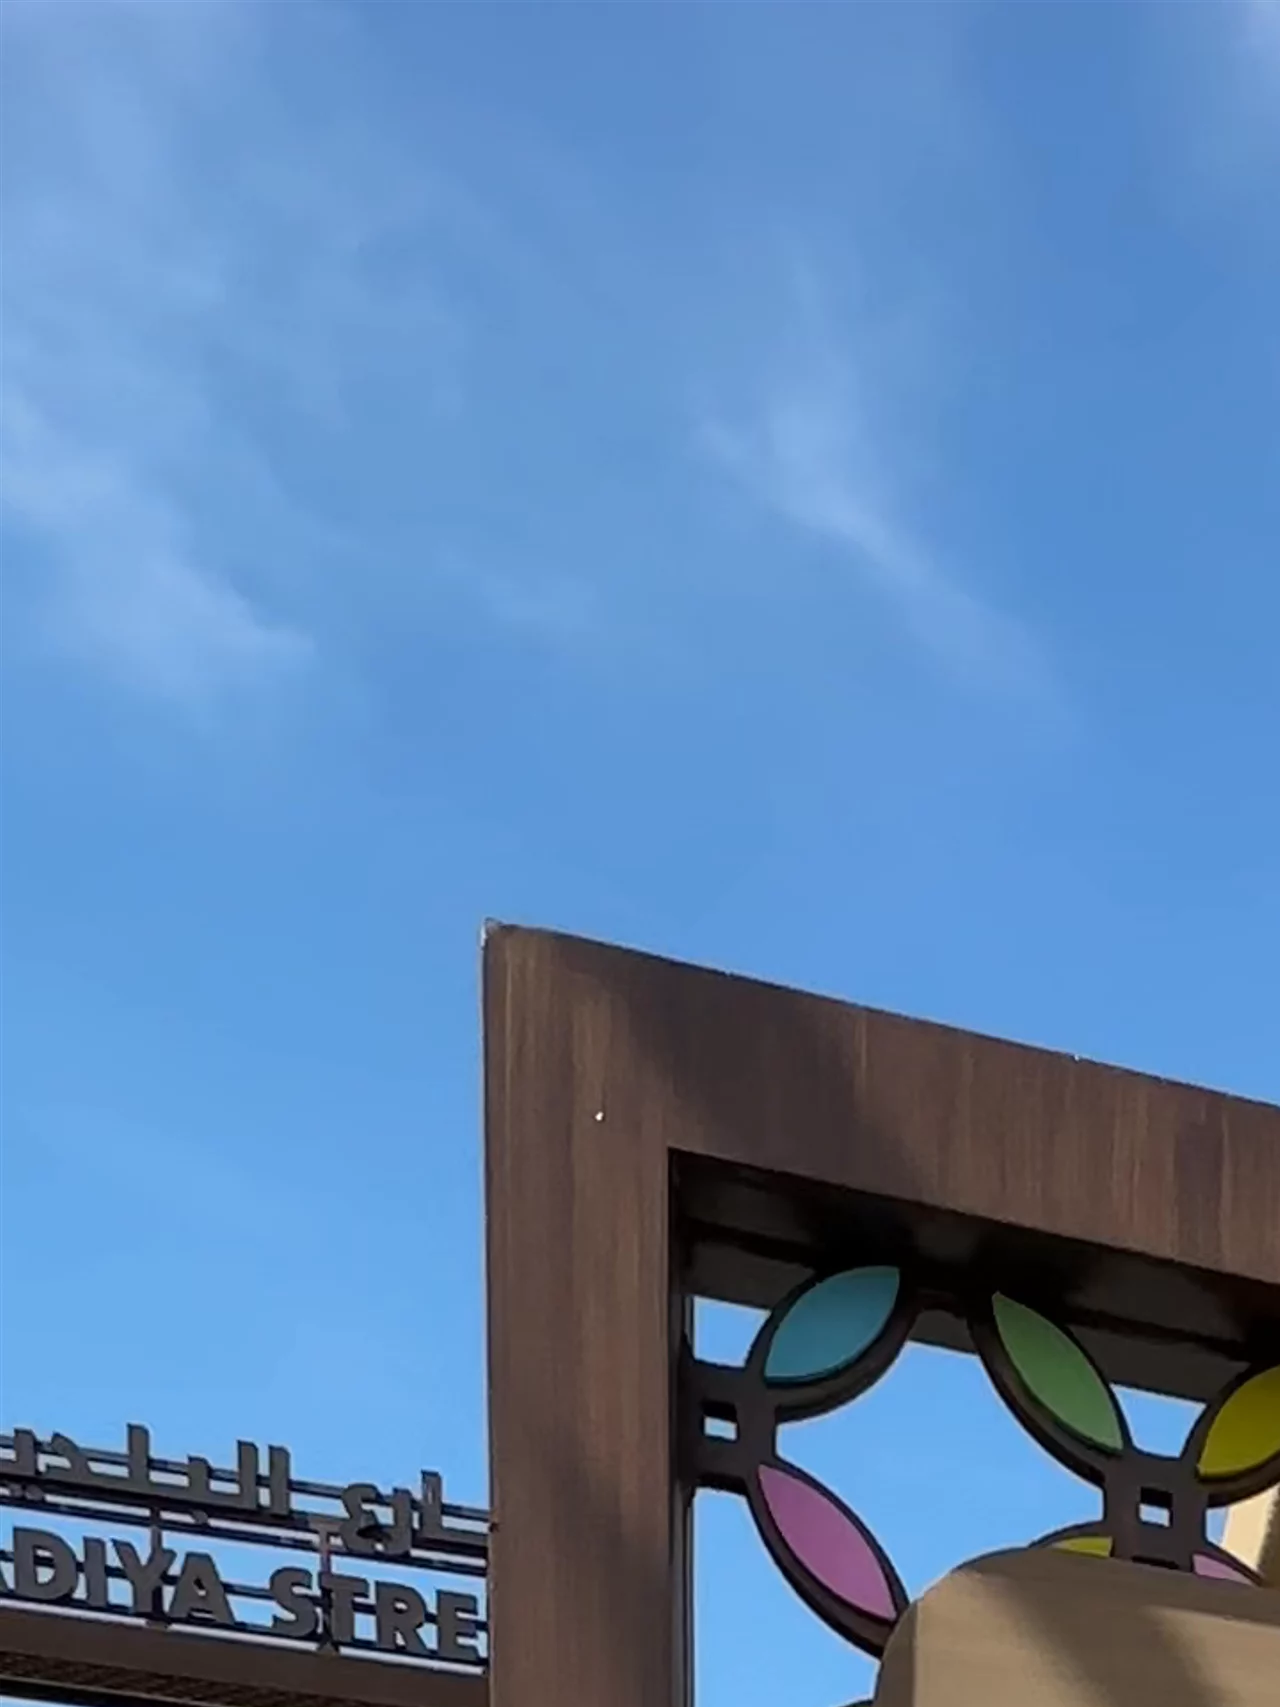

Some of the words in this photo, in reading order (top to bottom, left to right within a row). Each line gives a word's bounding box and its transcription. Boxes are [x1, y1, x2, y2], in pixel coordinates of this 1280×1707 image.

[0, 1423, 291, 1524] البلدي
[342, 1470, 488, 1556] ارع
[270, 1567, 481, 1661] STRE
